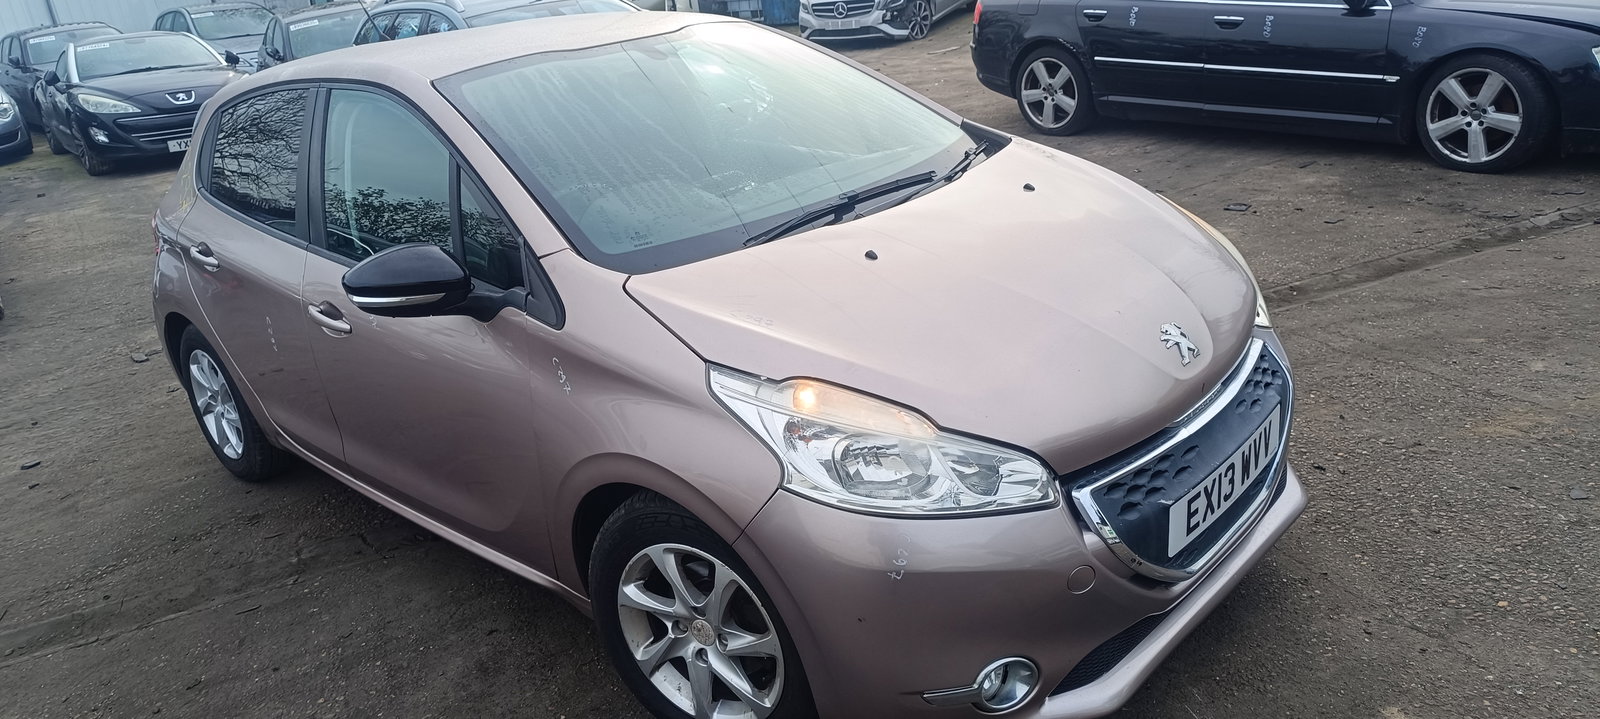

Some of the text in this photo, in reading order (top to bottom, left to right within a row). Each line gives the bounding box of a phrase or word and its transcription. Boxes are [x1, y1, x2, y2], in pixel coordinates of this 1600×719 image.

[176, 140, 192, 150] YX
[1186, 462, 1236, 537] EX13
[1241, 420, 1273, 486] WVV
